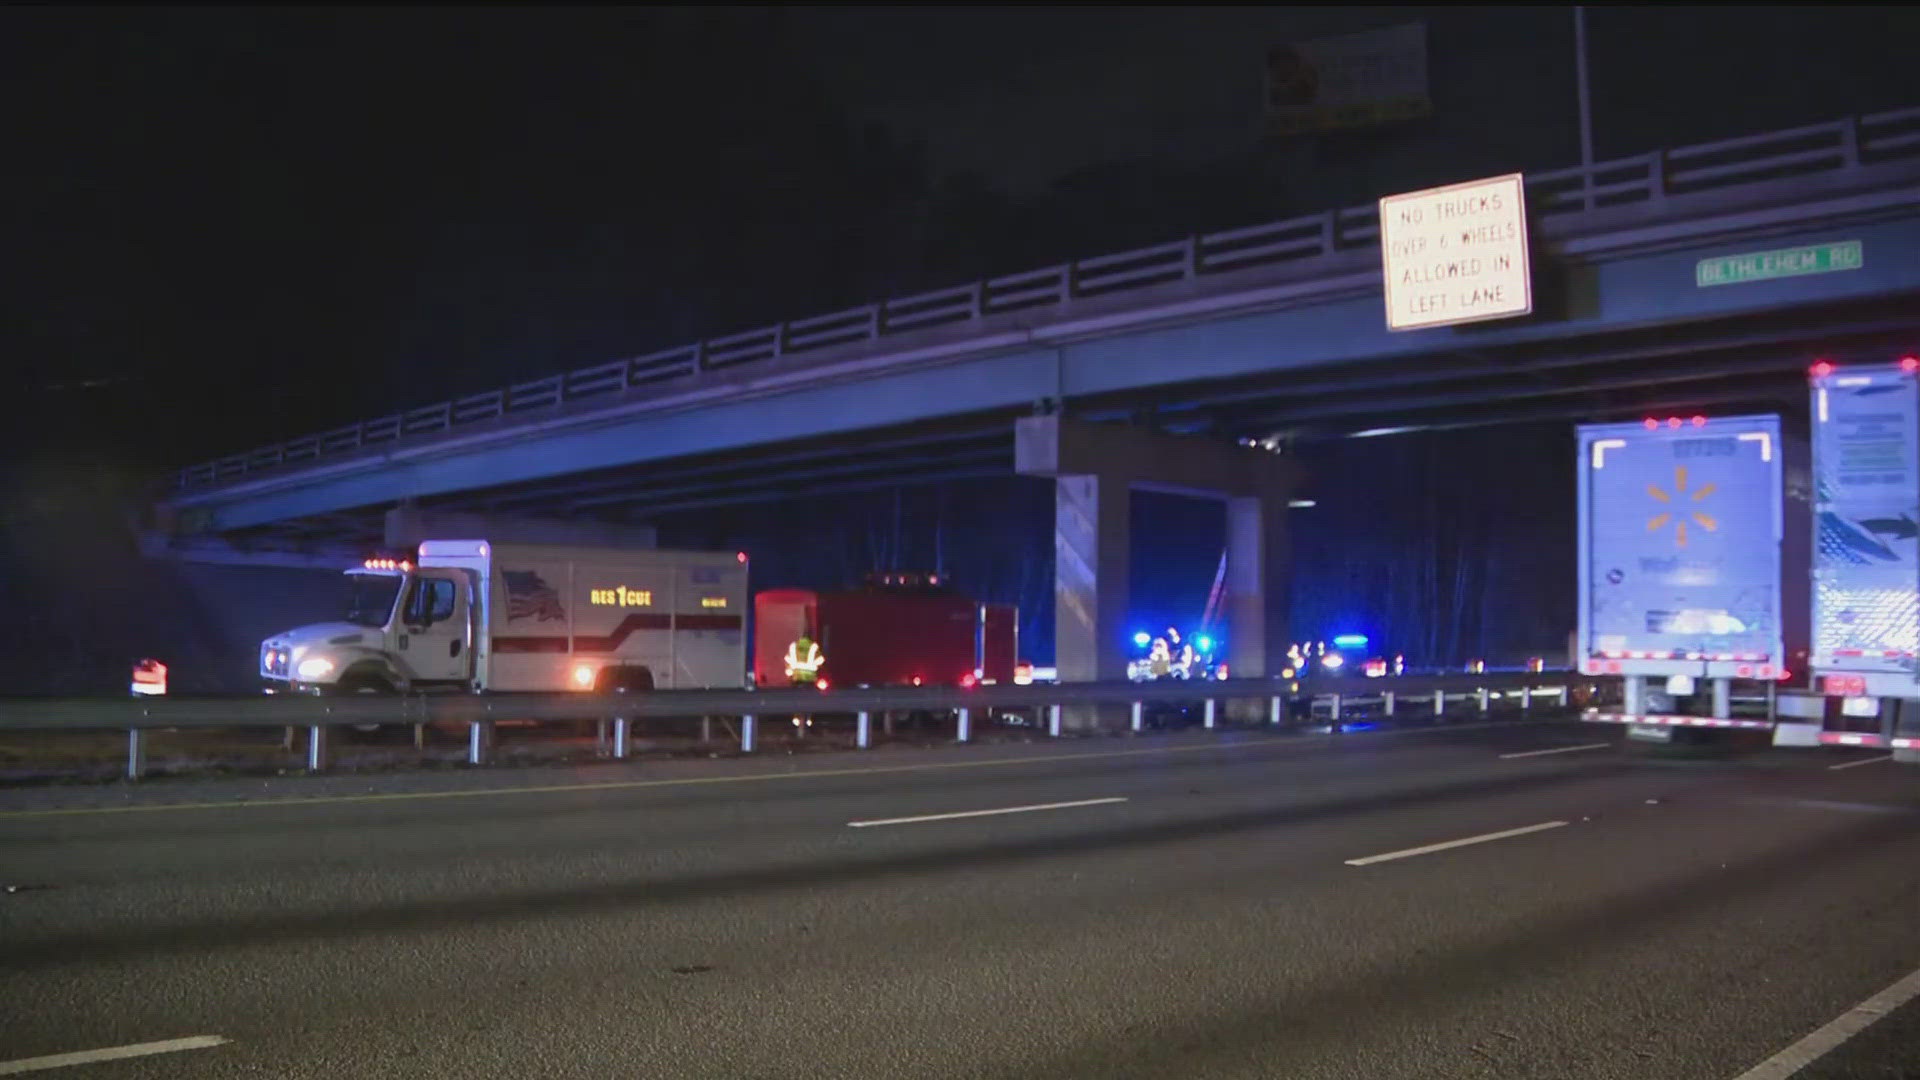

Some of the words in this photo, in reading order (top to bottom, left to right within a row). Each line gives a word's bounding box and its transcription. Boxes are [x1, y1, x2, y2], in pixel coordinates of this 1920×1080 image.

[1401, 209, 1423, 224] NO
[1436, 194, 1503, 219] TRUCKS
[1392, 237, 1427, 257] OVER
[1440, 233, 1449, 249] 6
[1461, 222, 1516, 245] WHEELS
[1403, 257, 1481, 285] ALLOWED
[1494, 253, 1510, 272] IN
[1702, 249, 1817, 282] BETHLEHEM
[1830, 245, 1858, 266] RD
[1410, 293, 1447, 314] LEFT
[1461, 285, 1505, 307] LANE
